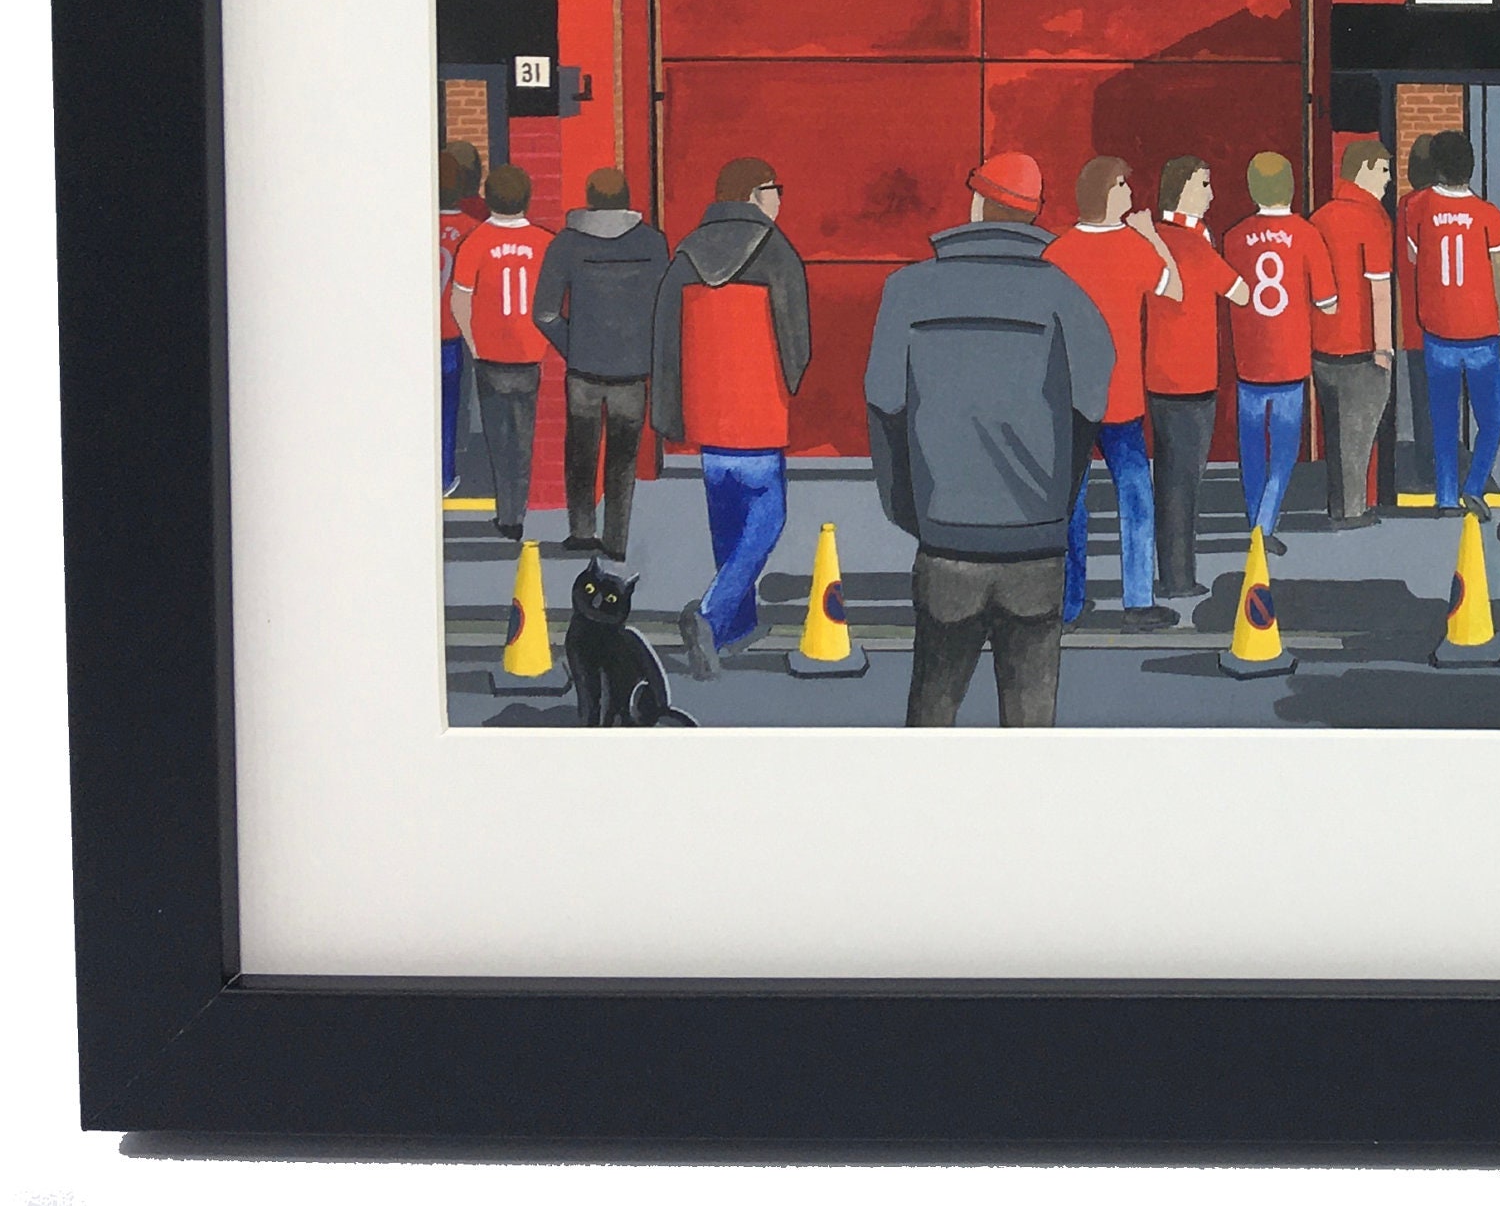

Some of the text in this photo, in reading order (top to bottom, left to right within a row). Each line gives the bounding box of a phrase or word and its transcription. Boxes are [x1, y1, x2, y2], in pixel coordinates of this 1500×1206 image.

[521, 62, 541, 83] 31
[1252, 250, 1290, 317] 8
[1440, 233, 1465, 287] 11
[502, 266, 528, 316] 11
